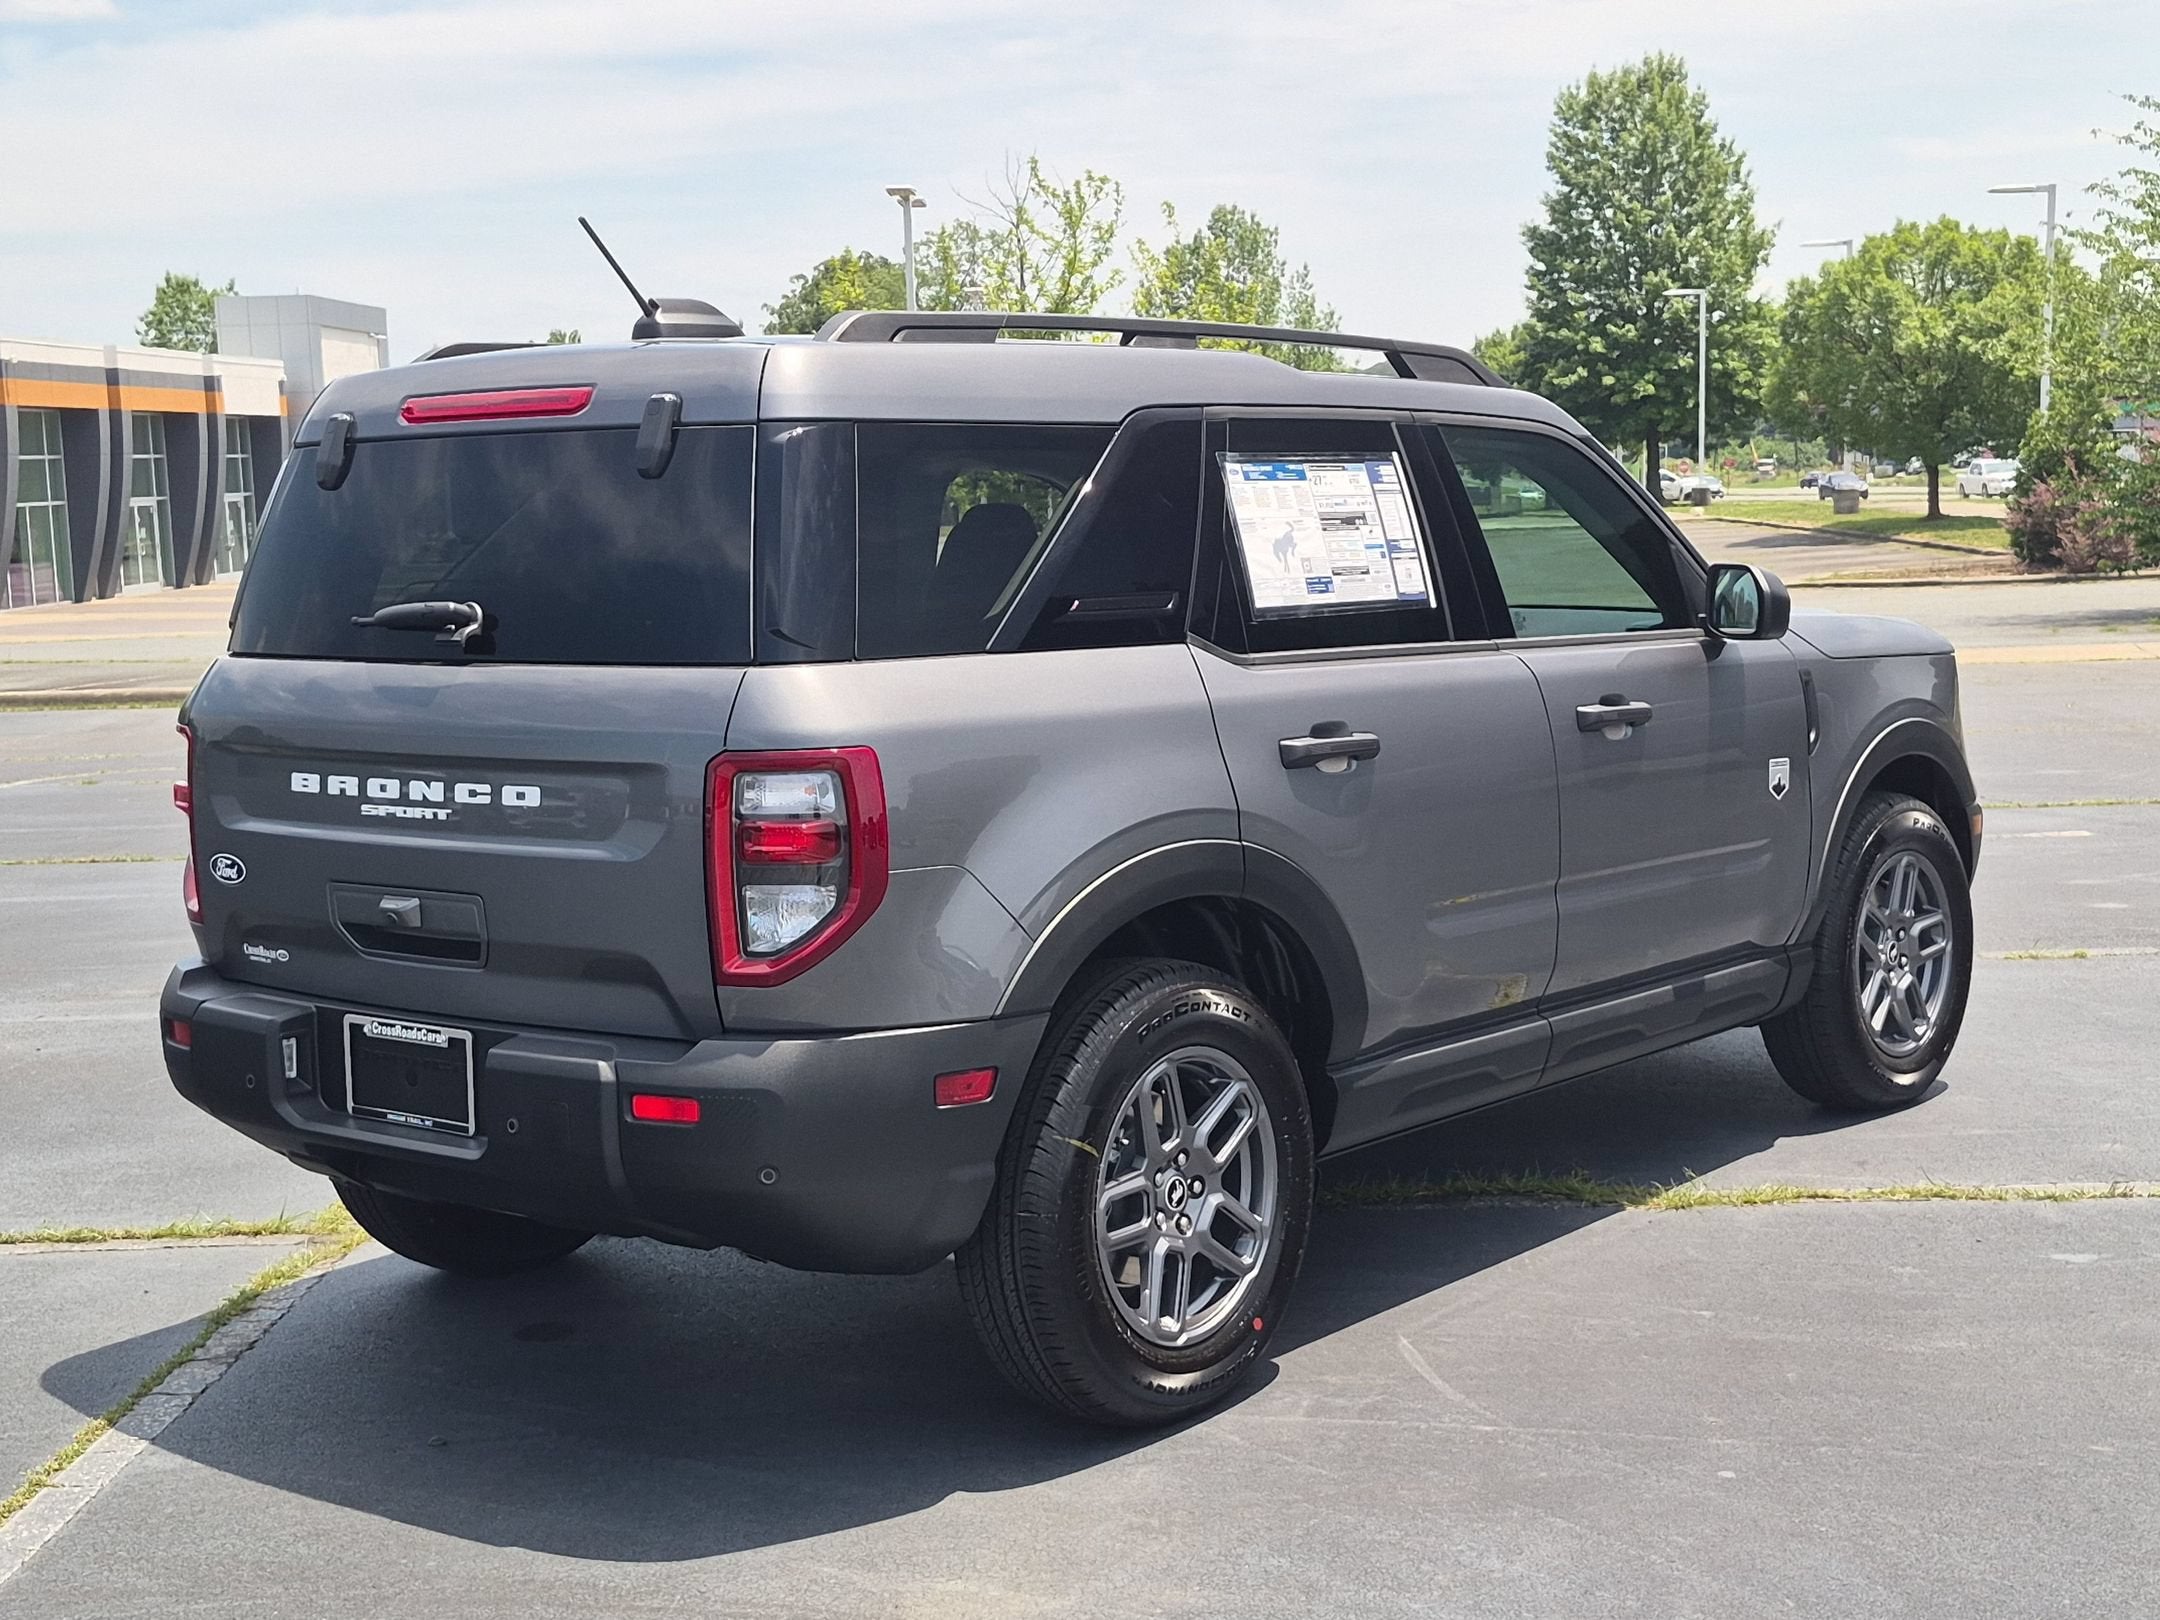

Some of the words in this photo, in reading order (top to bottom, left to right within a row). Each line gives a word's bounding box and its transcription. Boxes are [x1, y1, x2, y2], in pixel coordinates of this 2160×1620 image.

[290, 772, 541, 807] BRONCO
[360, 804, 452, 820] SPORT
[215, 857, 239, 879] Ford
